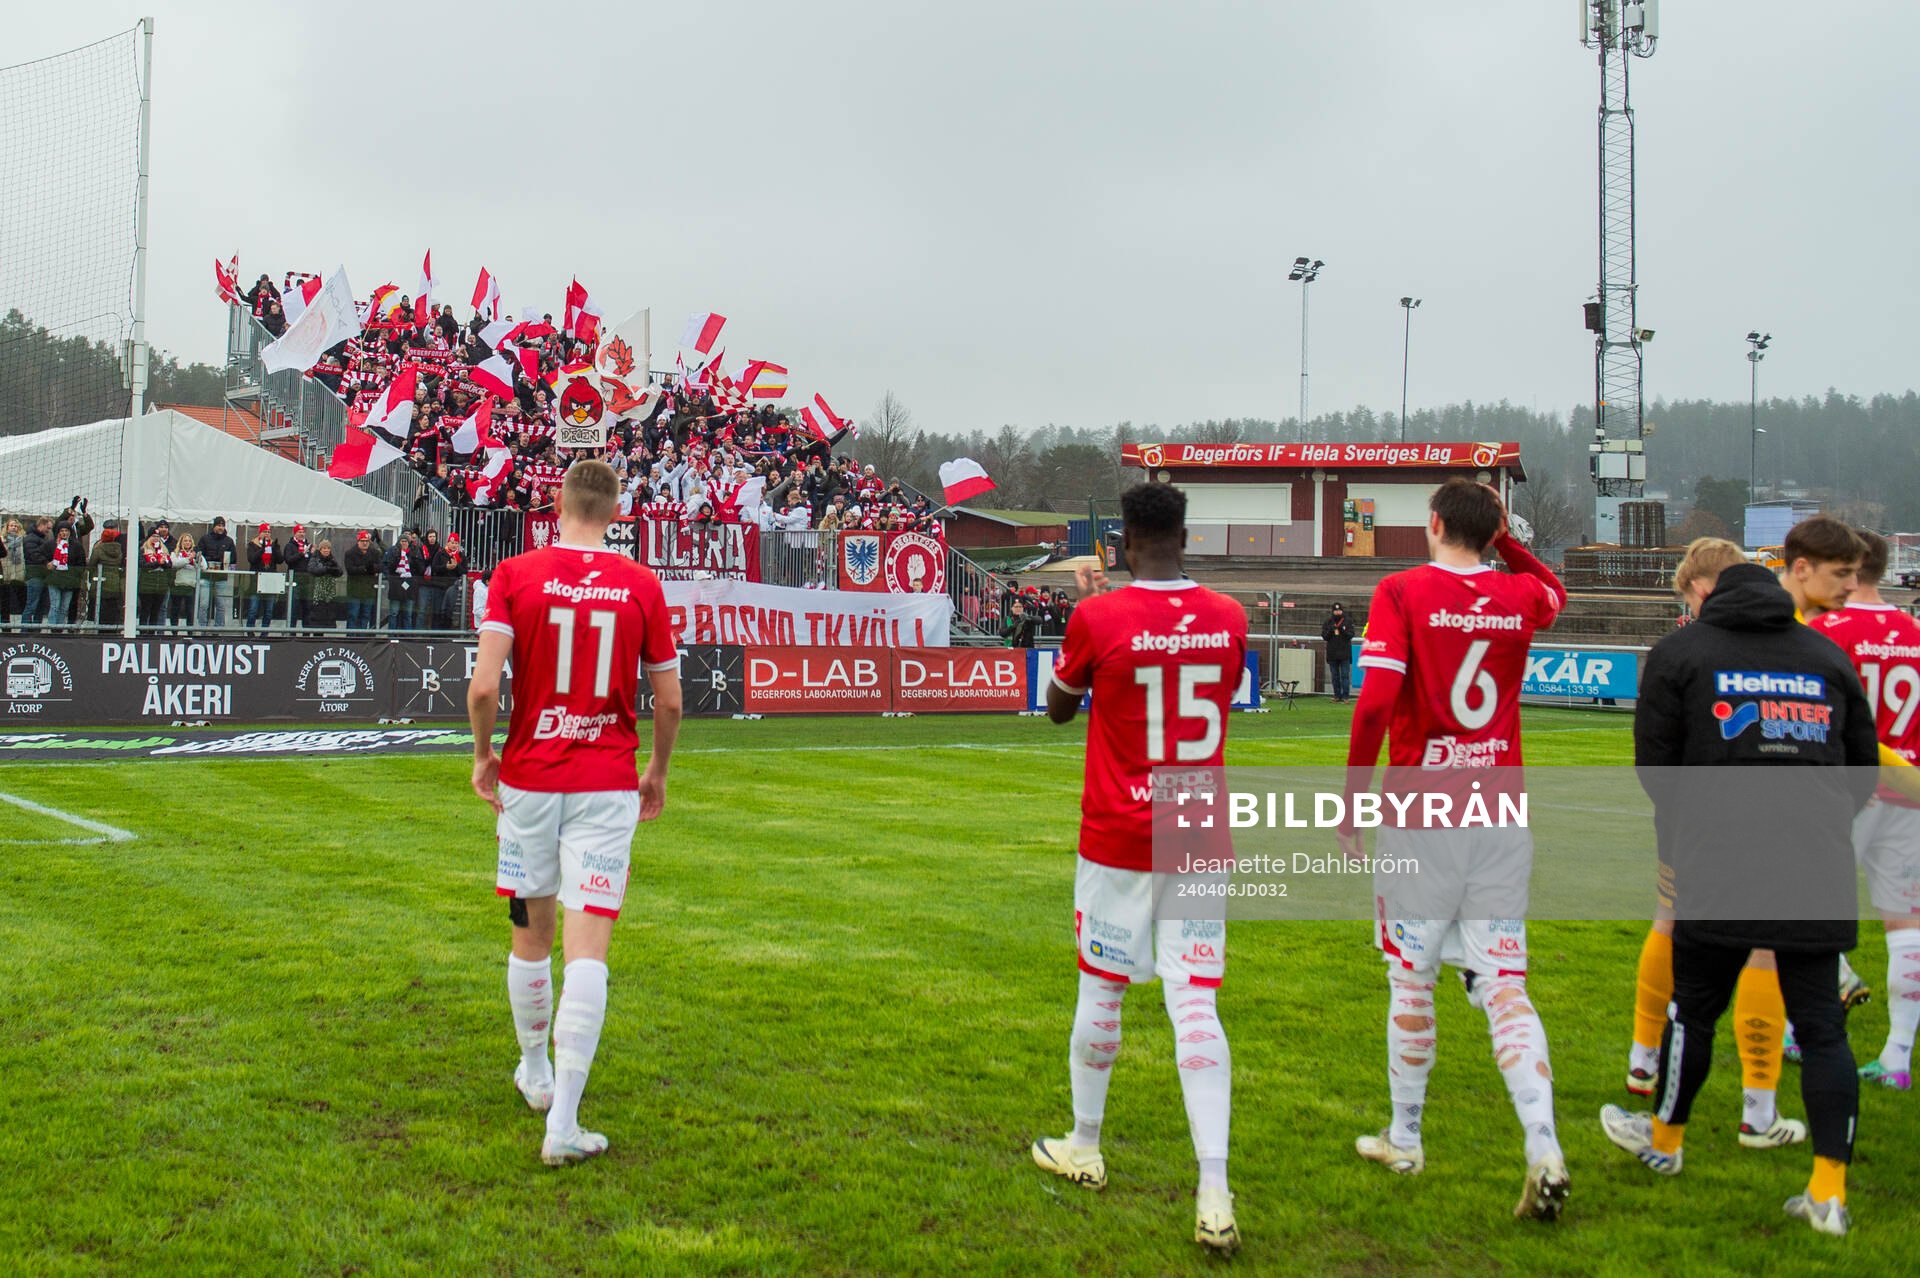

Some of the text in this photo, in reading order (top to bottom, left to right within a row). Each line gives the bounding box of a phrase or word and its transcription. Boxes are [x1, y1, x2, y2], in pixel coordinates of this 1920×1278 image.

[1182, 444, 1263, 465] Degerfors
[1267, 445, 1285, 461] IF
[1301, 445, 1338, 461] Hela
[1344, 444, 1419, 465] Sveriges
[1424, 444, 1451, 464] lag
[893, 535, 940, 555] DEGERFORS
[543, 577, 631, 603] skogsmat
[1428, 608, 1523, 633] skogsmat
[548, 606, 617, 698] 11
[1131, 630, 1230, 655] skogsmat
[1855, 640, 1920, 660] skogsma
[32, 643, 73, 692] PALMQVIST
[101, 642, 271, 677] PALMQVIST
[295, 660, 314, 692] ÅKERI
[313, 650, 326, 664] AB
[338, 647, 374, 692] PALMQVIST
[750, 658, 879, 688] D-LAB
[900, 659, 1018, 688] D-LAB
[1451, 640, 1498, 730] 6
[1717, 673, 1822, 697] Helmia
[141, 676, 232, 716] ÅKERI
[751, 689, 882, 699] DEGERFORS LABORATORIUM AB
[901, 689, 1021, 699] DEGERFORS LABORATORIUM AB
[1538, 684, 1584, 695] 0584-133
[1586, 685, 1600, 695] 35
[1860, 663, 1920, 738] 19
[8, 702, 43, 714] ÅTORP
[319, 701, 349, 713] ÅTORP
[1134, 664, 1222, 761] 15
[1760, 700, 1830, 725] INTER
[1760, 719, 1831, 744] SPORT
[1148, 770, 1214, 789] NORDIC
[589, 873, 611, 890] ICA
[1193, 942, 1215, 958] ICA
[1499, 938, 1520, 951] ICA
